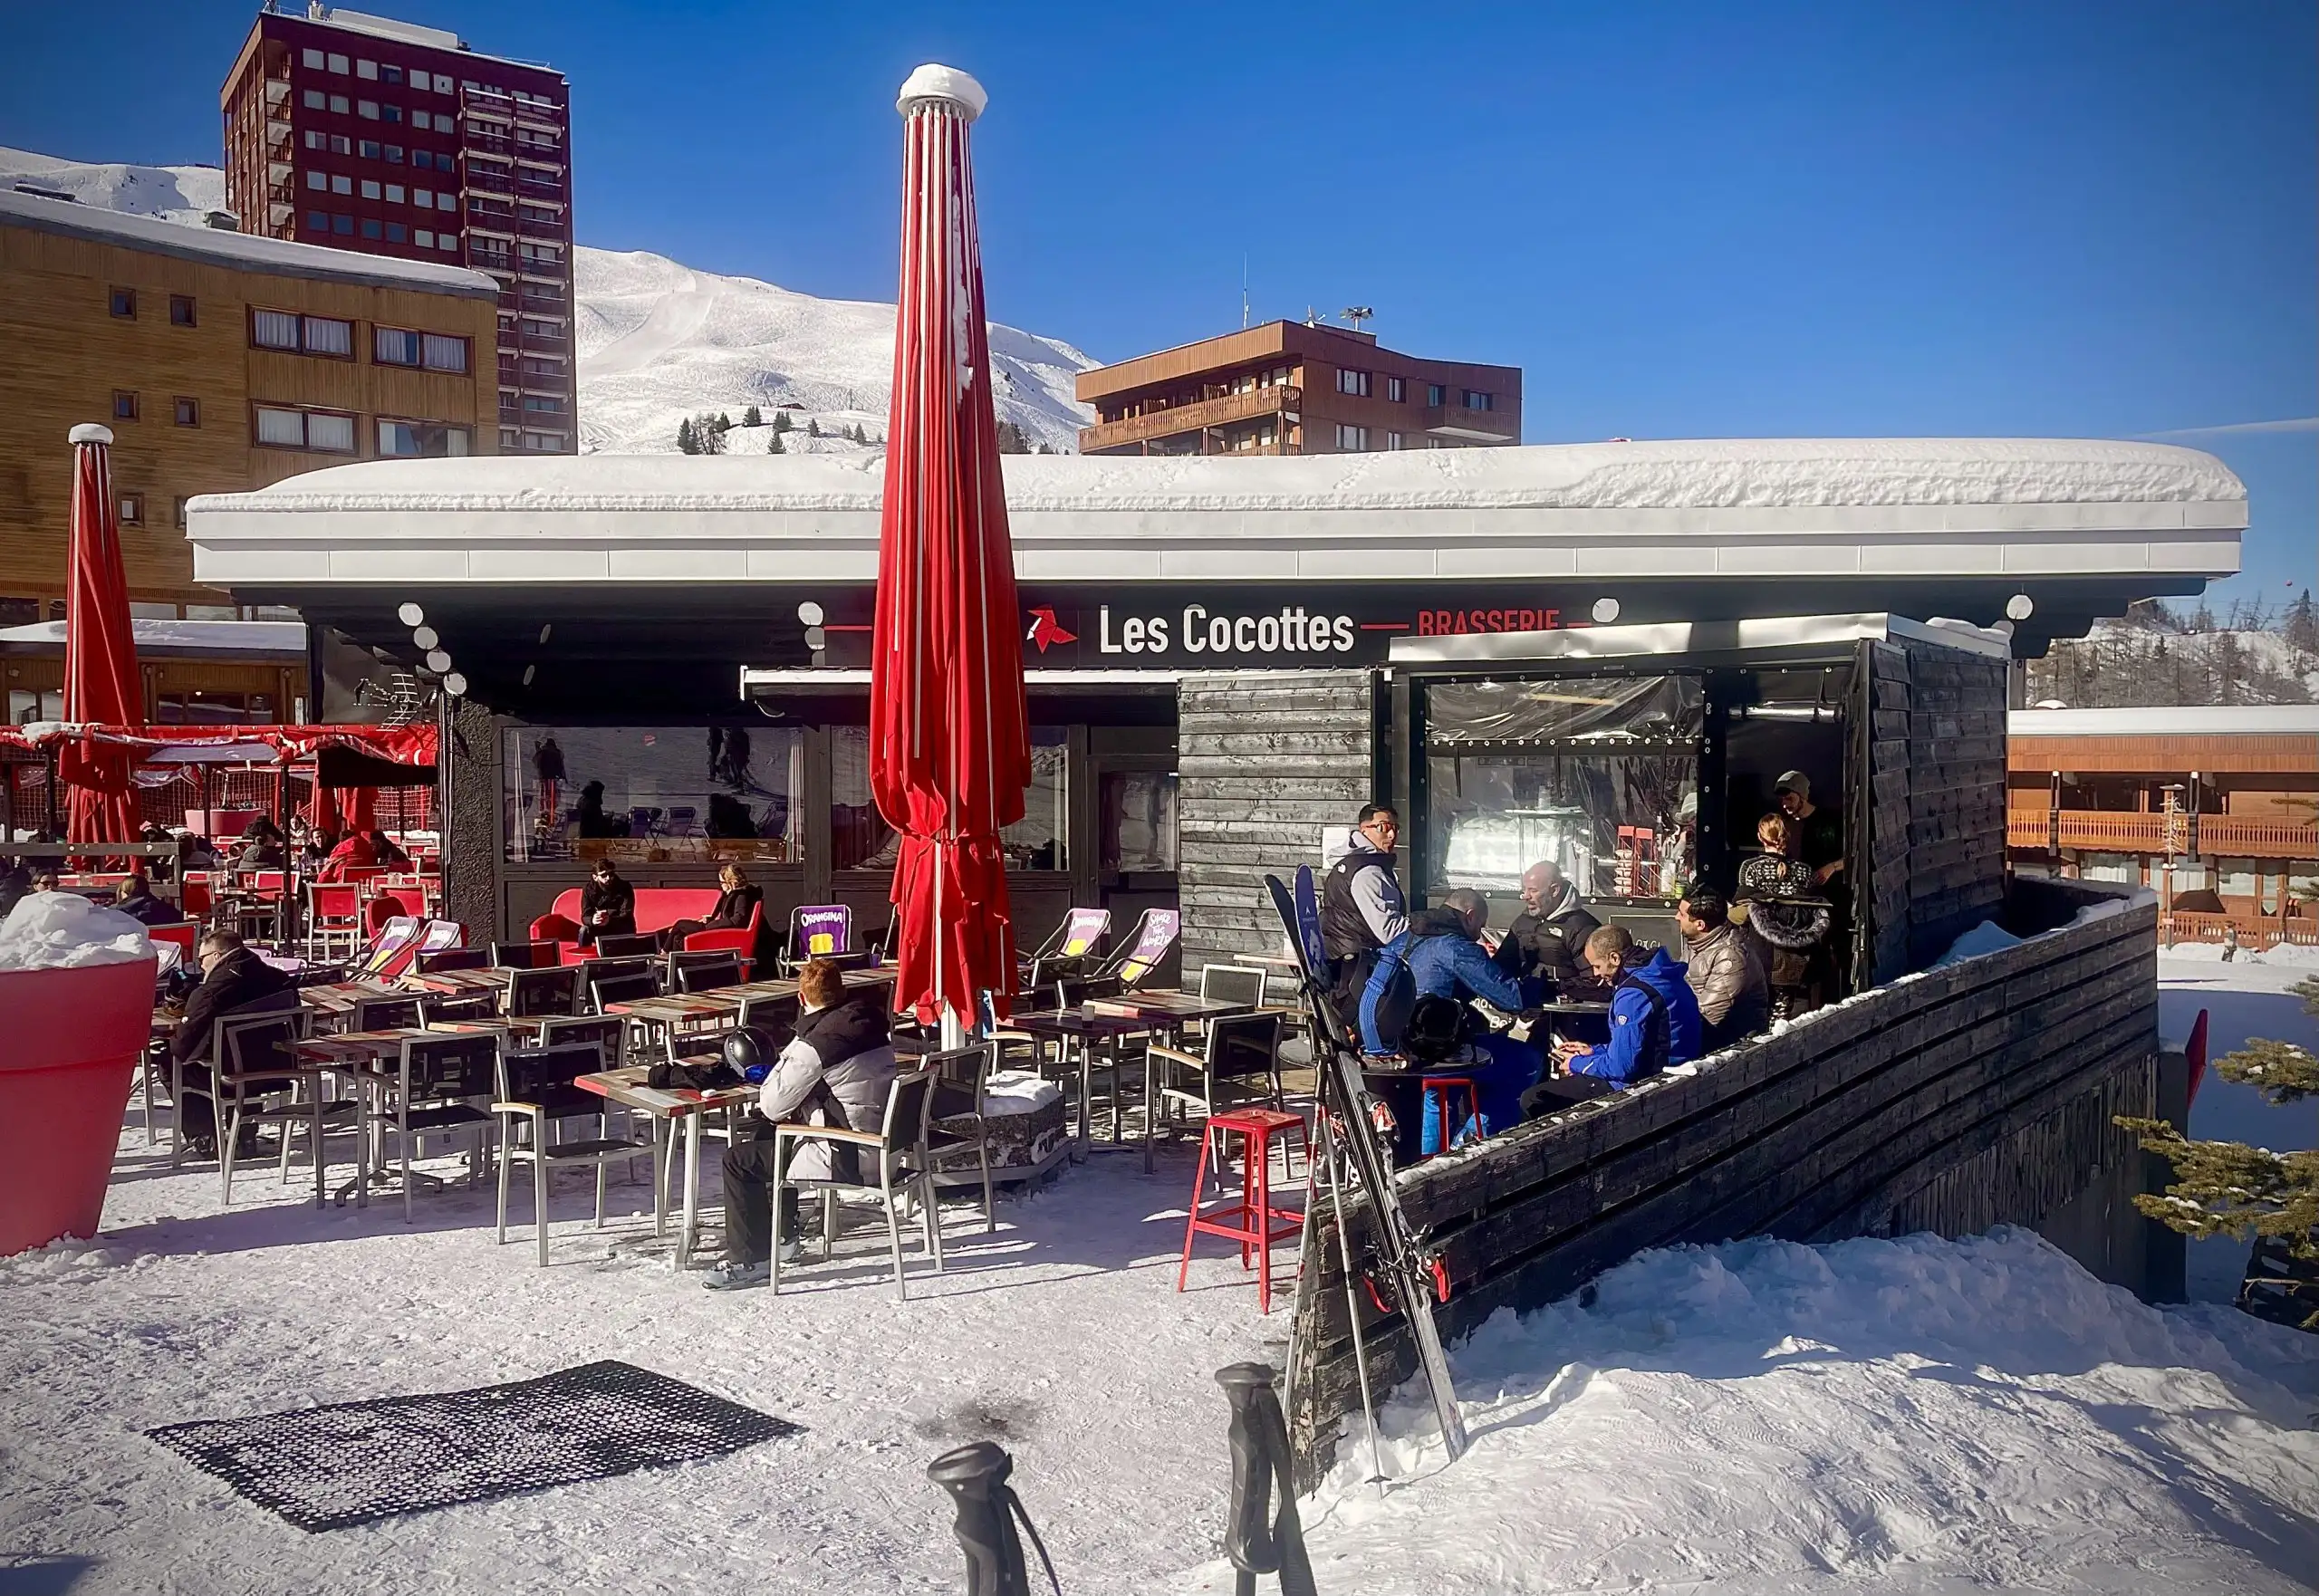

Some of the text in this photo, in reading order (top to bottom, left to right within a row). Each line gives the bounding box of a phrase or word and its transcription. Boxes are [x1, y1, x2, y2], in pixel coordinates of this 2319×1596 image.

[1100, 603, 1354, 654] Les Cocottes
[1418, 610, 1560, 636] BRASSERIE
[801, 911, 843, 928] ORANGINA
